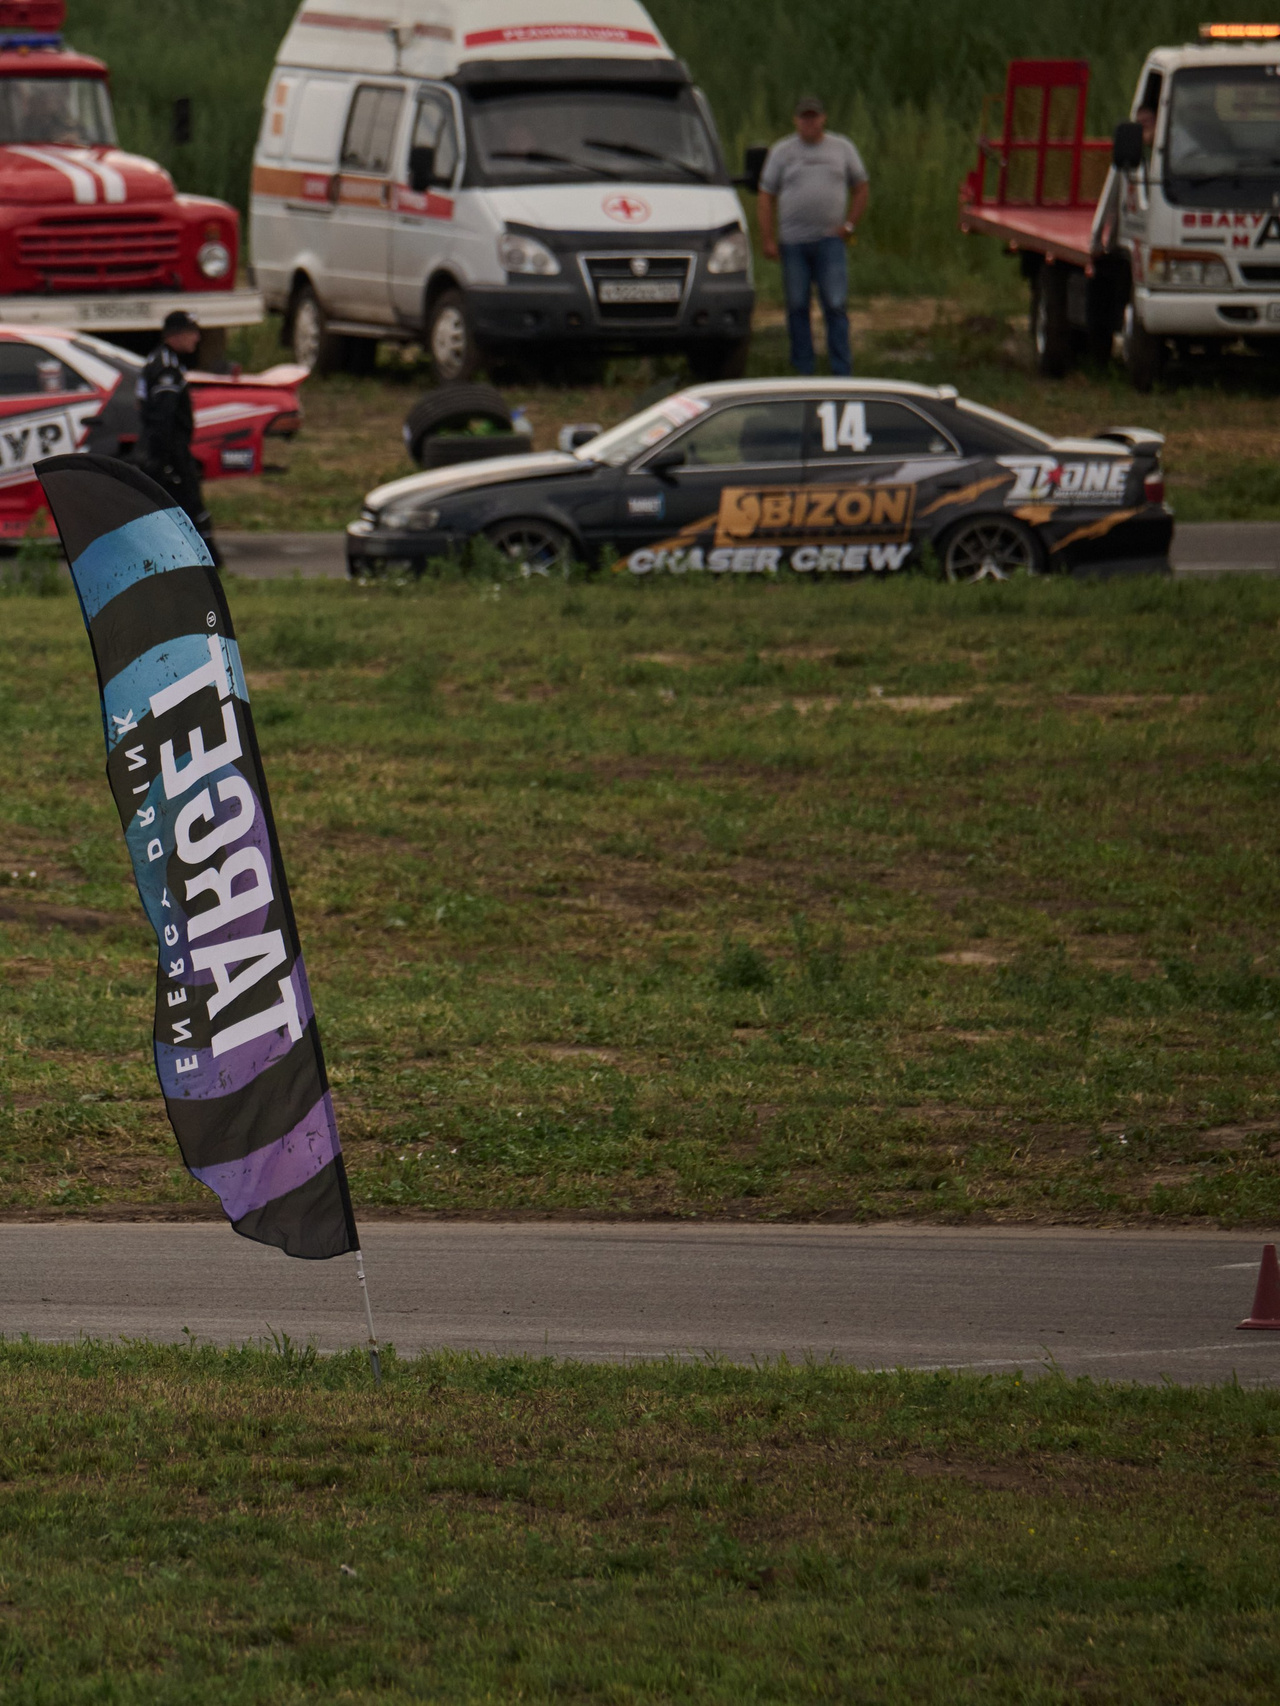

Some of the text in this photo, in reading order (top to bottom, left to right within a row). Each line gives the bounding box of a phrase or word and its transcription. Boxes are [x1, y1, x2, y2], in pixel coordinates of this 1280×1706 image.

[817, 401, 872, 451] 14
[760, 489, 907, 528] BIZON
[790, 544, 912, 572] CREW
